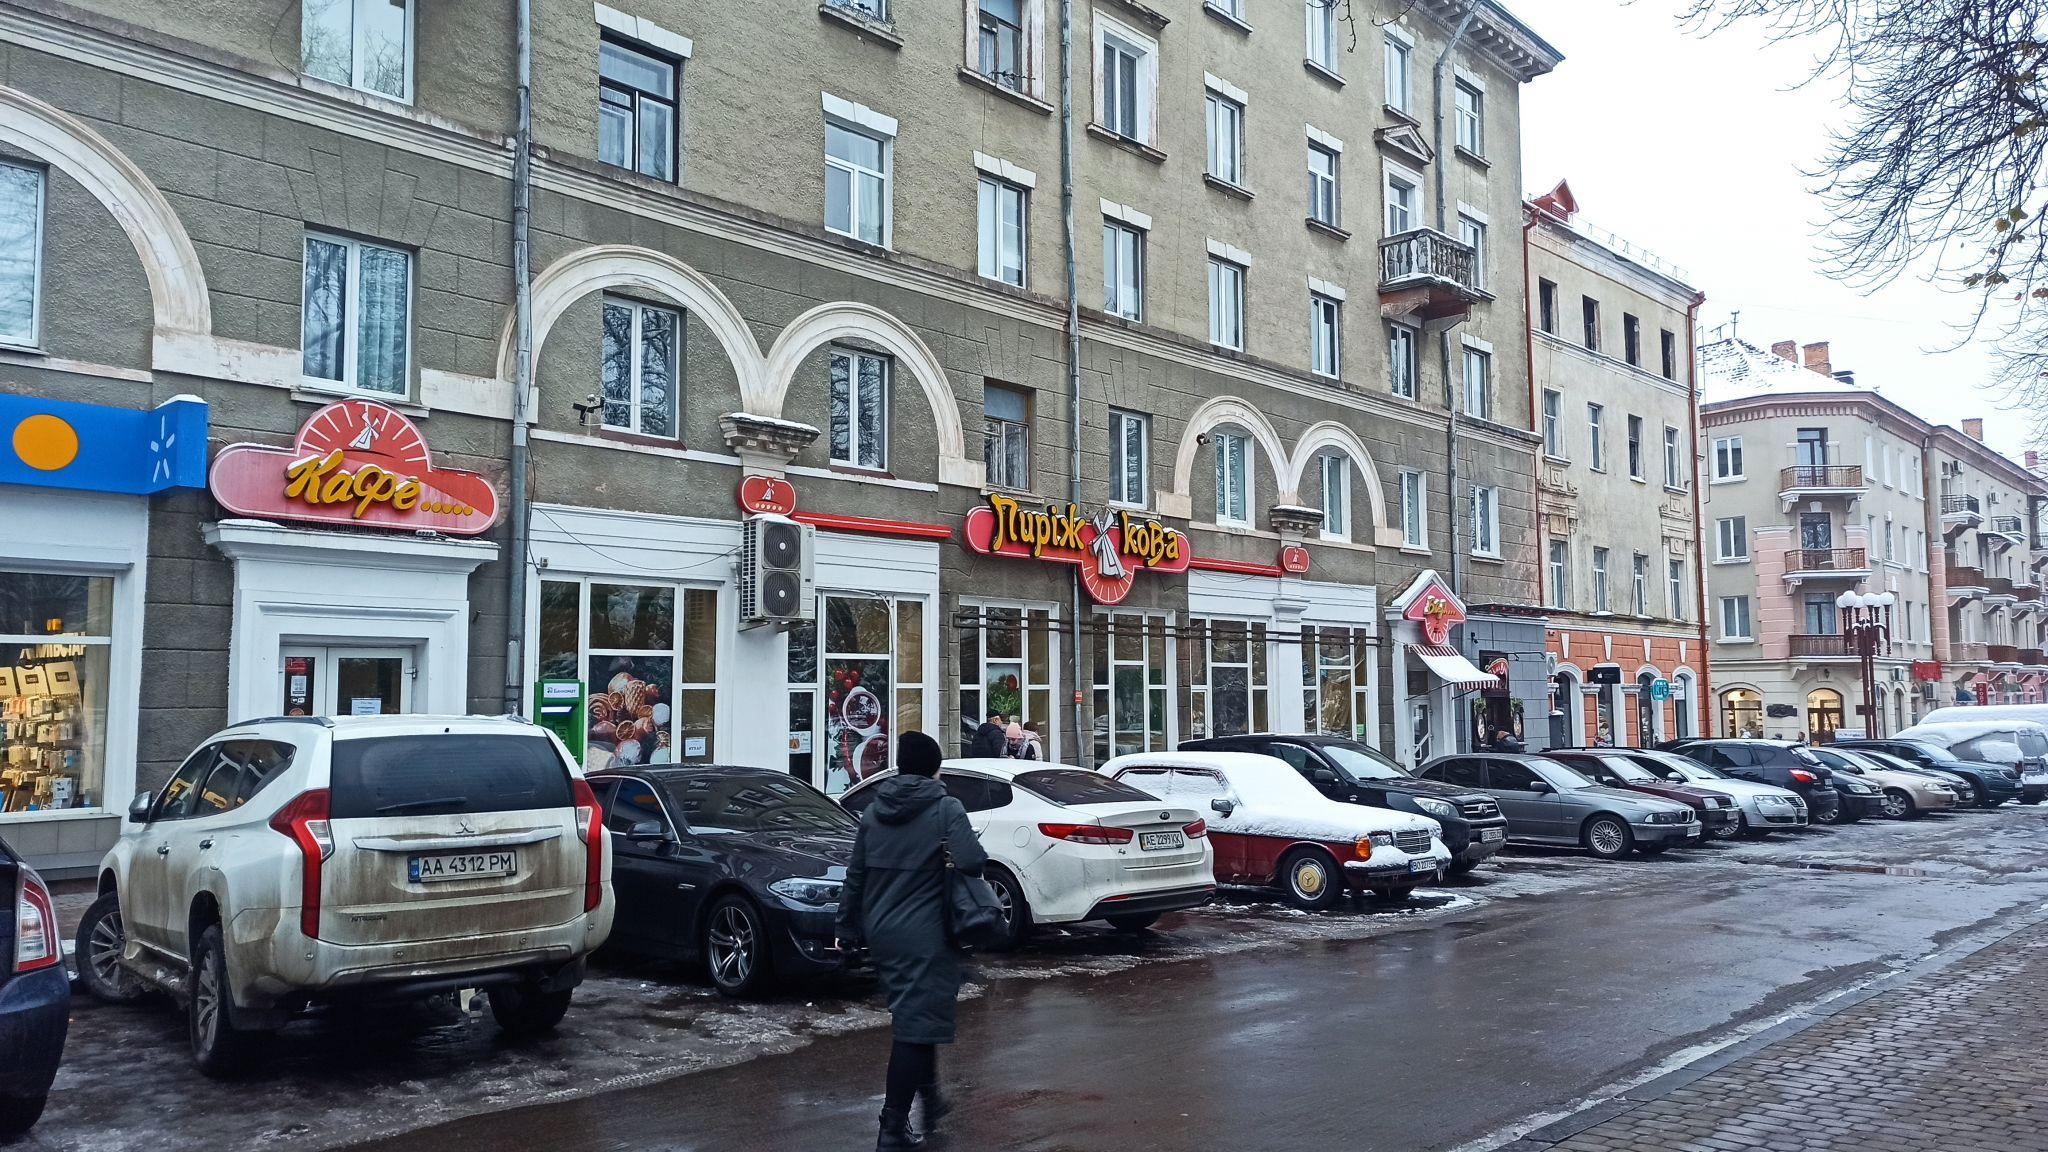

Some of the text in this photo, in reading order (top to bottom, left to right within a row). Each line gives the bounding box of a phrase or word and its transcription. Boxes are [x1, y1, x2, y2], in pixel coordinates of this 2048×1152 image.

[988, 493, 1085, 557] Пиріж
[1145, 835, 1156, 846] AE
[422, 854, 512, 875] AA 4312 PM
